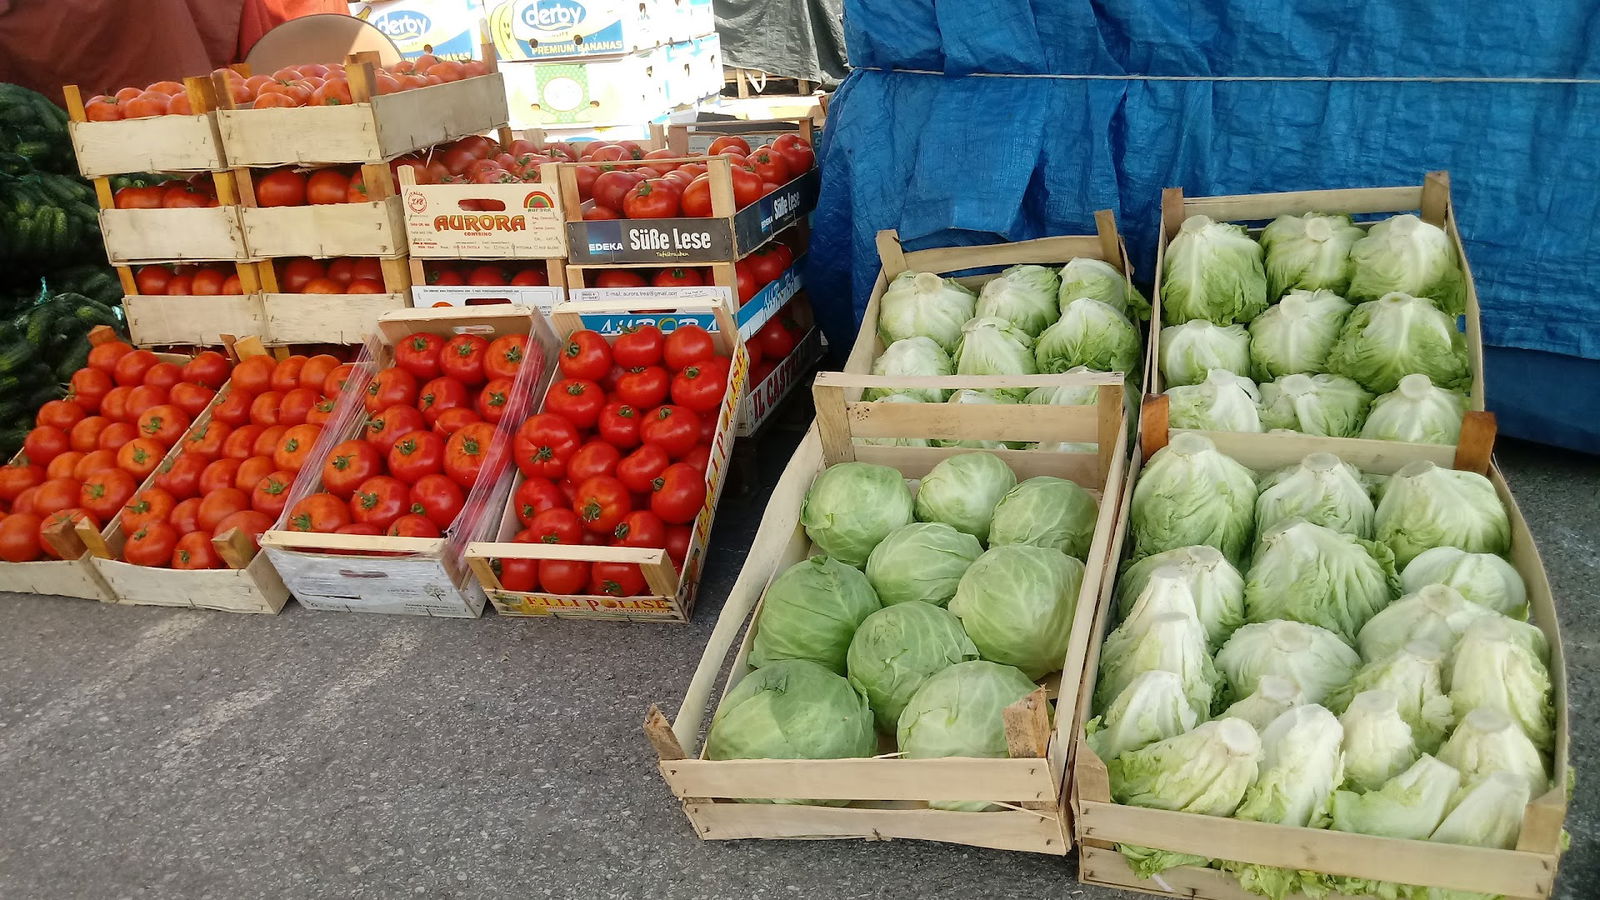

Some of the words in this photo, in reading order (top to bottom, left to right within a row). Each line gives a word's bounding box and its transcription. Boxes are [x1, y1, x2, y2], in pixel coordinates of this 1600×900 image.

[378, 11, 427, 37] derby
[526, 3, 582, 26] derby
[531, 44, 575, 55] PREMIUM
[578, 40, 622, 52] BANANAS
[434, 215, 526, 232] AURORA
[589, 243, 623, 251] EDEKA
[629, 229, 670, 251] Süße
[673, 228, 711, 250] Lese
[753, 389, 766, 421] IL
